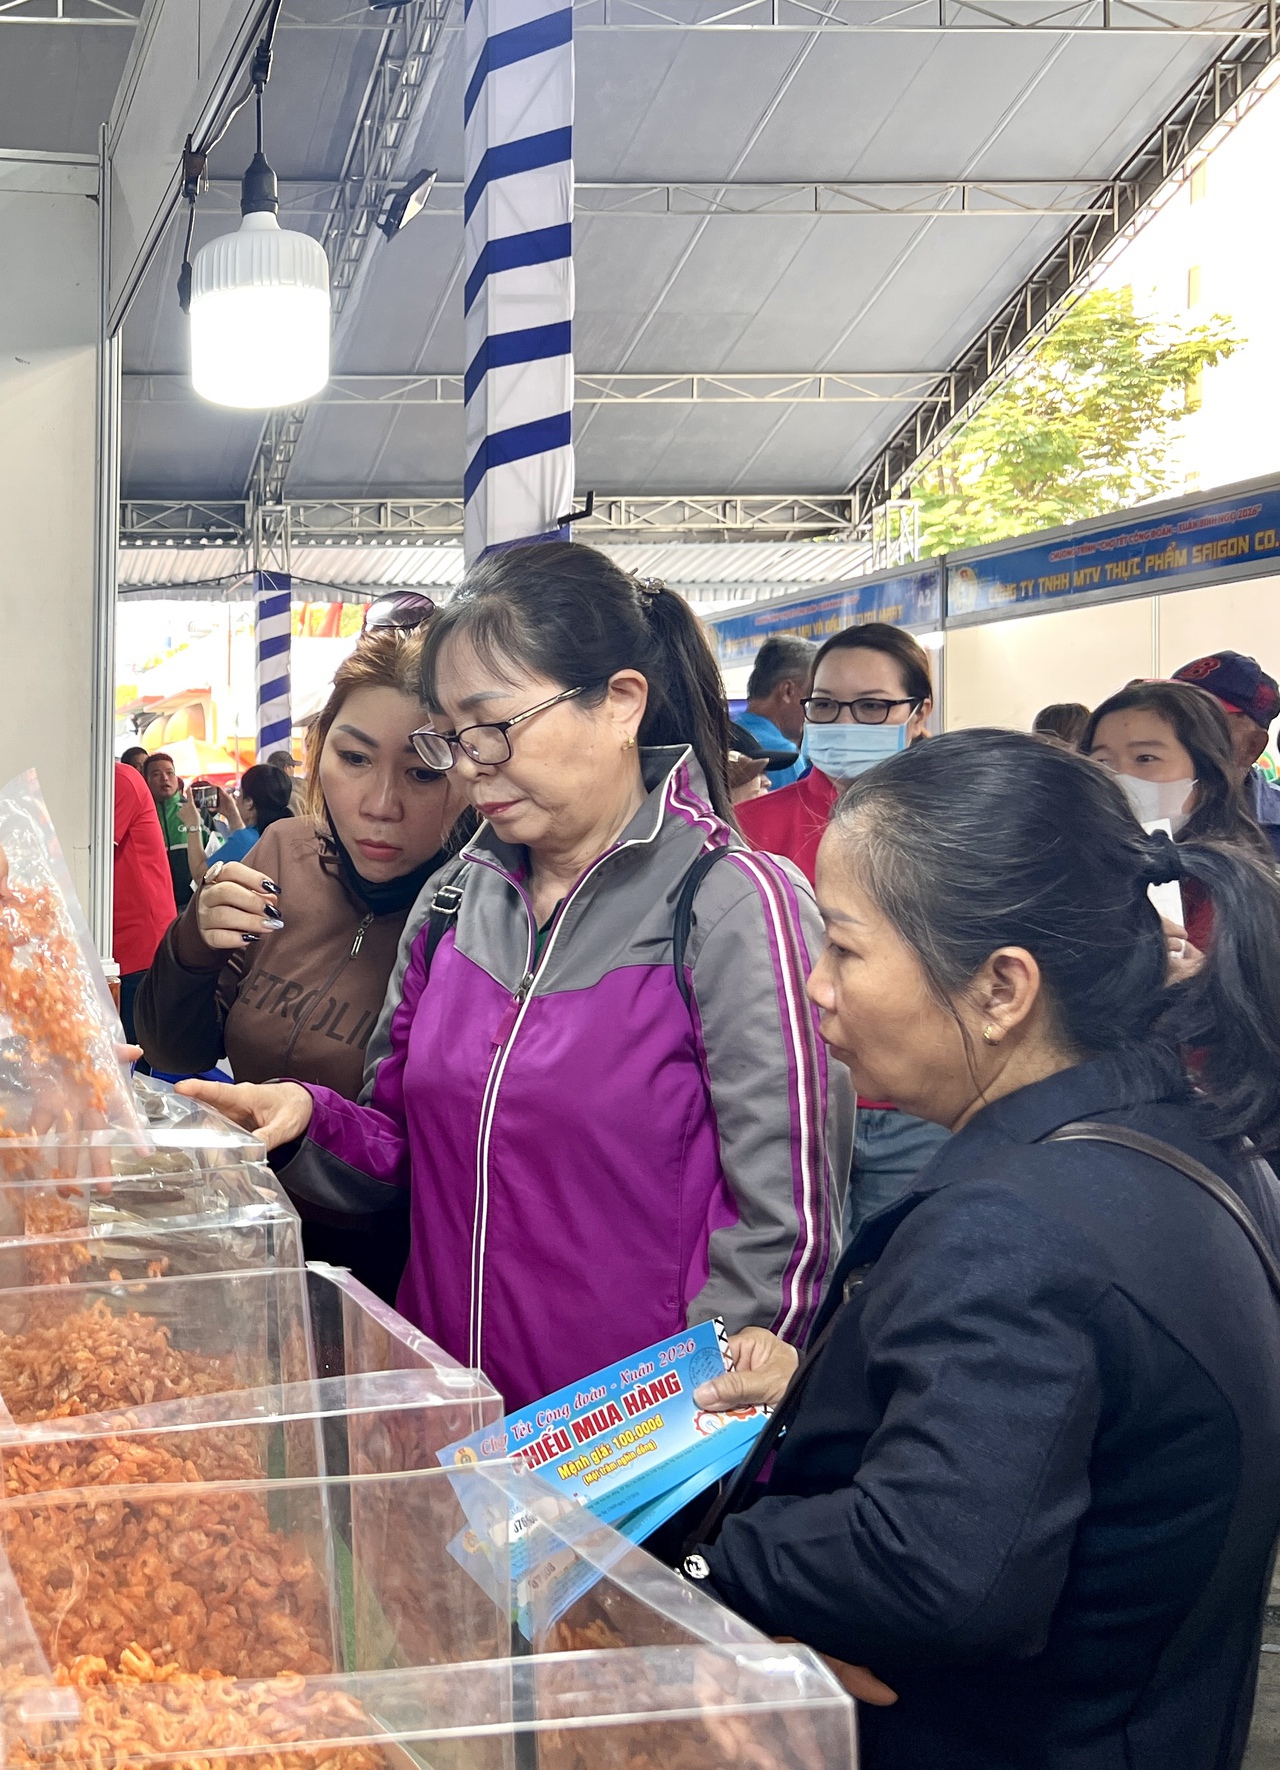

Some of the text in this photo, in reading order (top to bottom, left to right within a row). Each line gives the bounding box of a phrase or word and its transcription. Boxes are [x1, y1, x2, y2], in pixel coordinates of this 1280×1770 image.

[1020, 579, 1034, 597] TY
[1037, 572, 1070, 594] TNHH
[1073, 565, 1101, 586] MTV
[1105, 556, 1142, 581] THỰC
[1145, 541, 1188, 573] PHẨM
[1191, 534, 1250, 564] SAIGON
[536, 1404, 571, 1429] Công
[574, 1386, 607, 1411] đoàn
[619, 1361, 655, 1389] Xuân
[658, 1337, 696, 1367] 2026
[571, 1401, 624, 1443] MUA
[622, 1371, 683, 1417] HÀNG
[557, 1455, 591, 1481] Mệnh
[593, 1444, 613, 1466] giá:
[612, 1412, 665, 1447] 100.000đ
[582, 1468, 601, 1487] (Một
